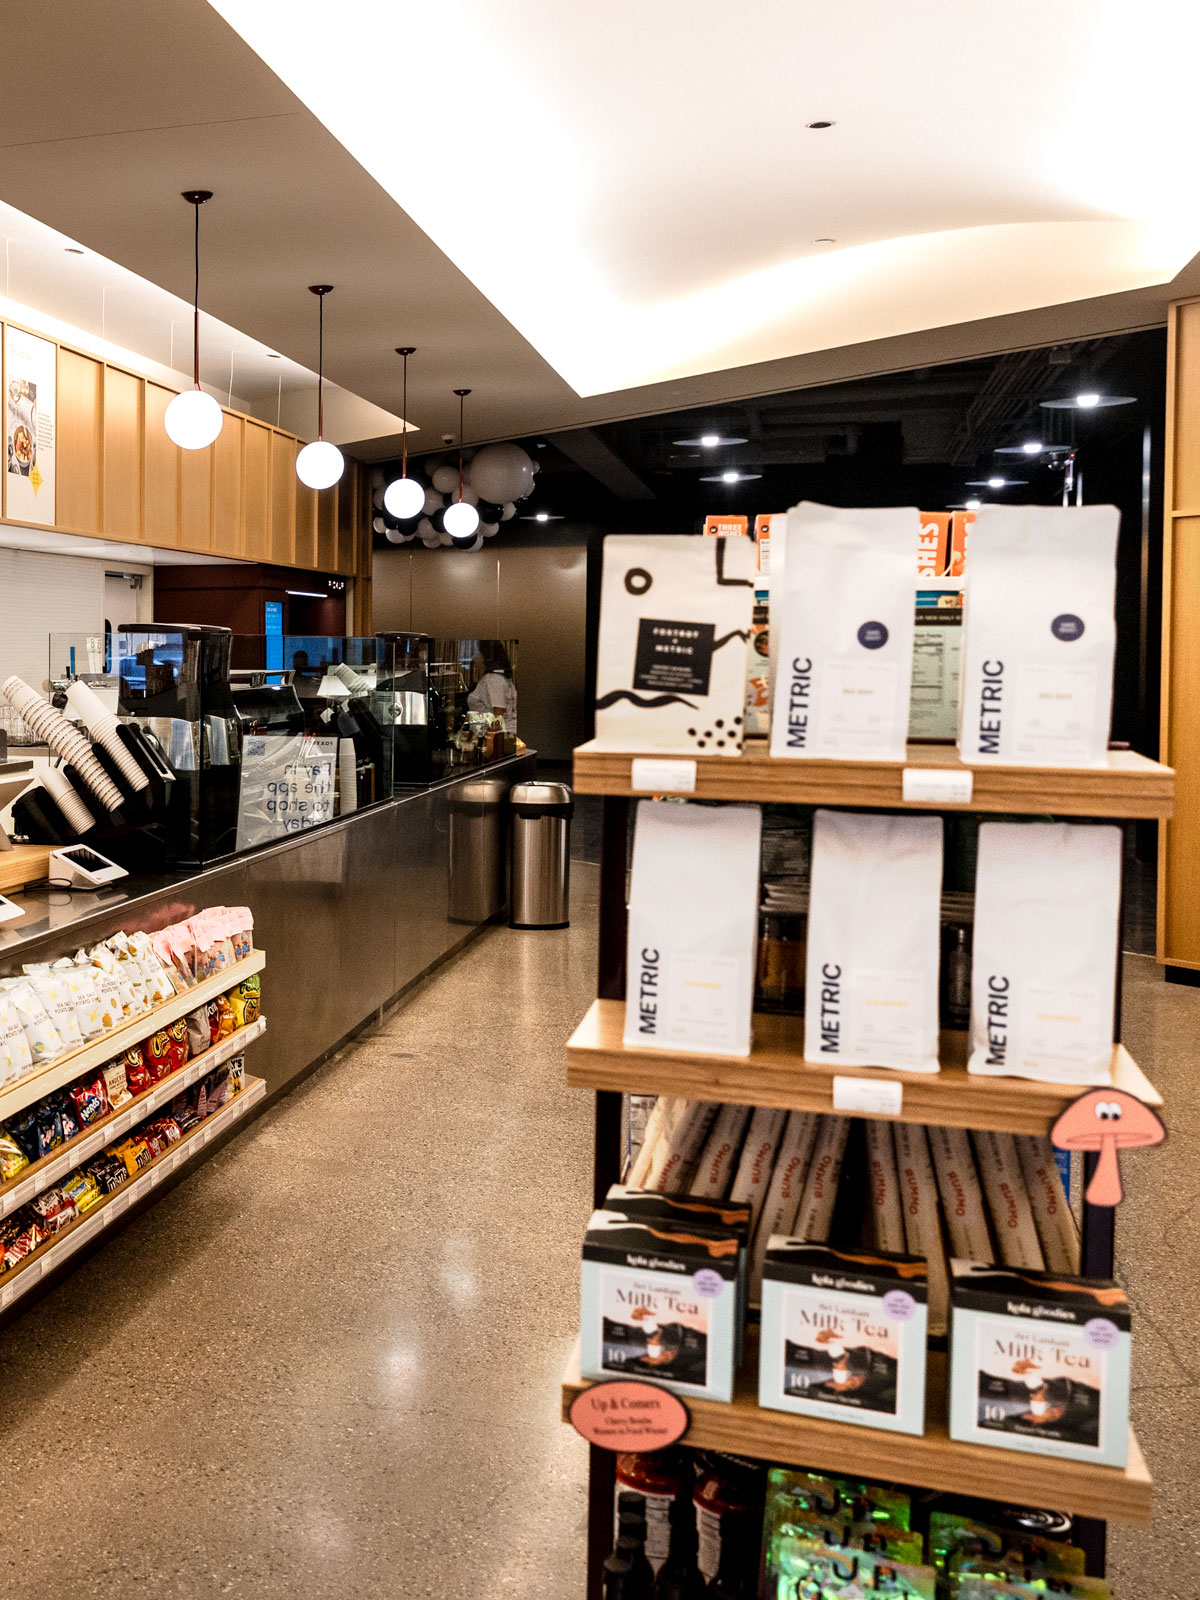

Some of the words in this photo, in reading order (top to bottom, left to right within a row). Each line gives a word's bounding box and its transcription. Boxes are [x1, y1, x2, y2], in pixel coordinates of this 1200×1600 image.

[786, 656, 813, 748] METRIC
[978, 659, 1004, 755] METRIC
[638, 946, 661, 1035] METRIC
[820, 962, 844, 1054] METRIC
[985, 974, 1011, 1068] METRIC
[80, 1097, 100, 1121] Nerds
[709, 1143, 731, 1184] RUMMO
[752, 1142, 772, 1184] RUMMO
[781, 1157, 800, 1199] RUMMO
[904, 1168, 919, 1215] RUMMO
[947, 1171, 966, 1217] RUMMO
[1000, 1183, 1018, 1228] RUMMO
[616, 1288, 658, 1309] Milk
[664, 1296, 699, 1315] Tea
[801, 1310, 845, 1331] Milk
[852, 1318, 889, 1339] Tea
[608, 1347, 627, 1364] 10
[994, 1339, 1044, 1362] Milk
[1051, 1347, 1091, 1369] Tea
[791, 1373, 810, 1388] 10
